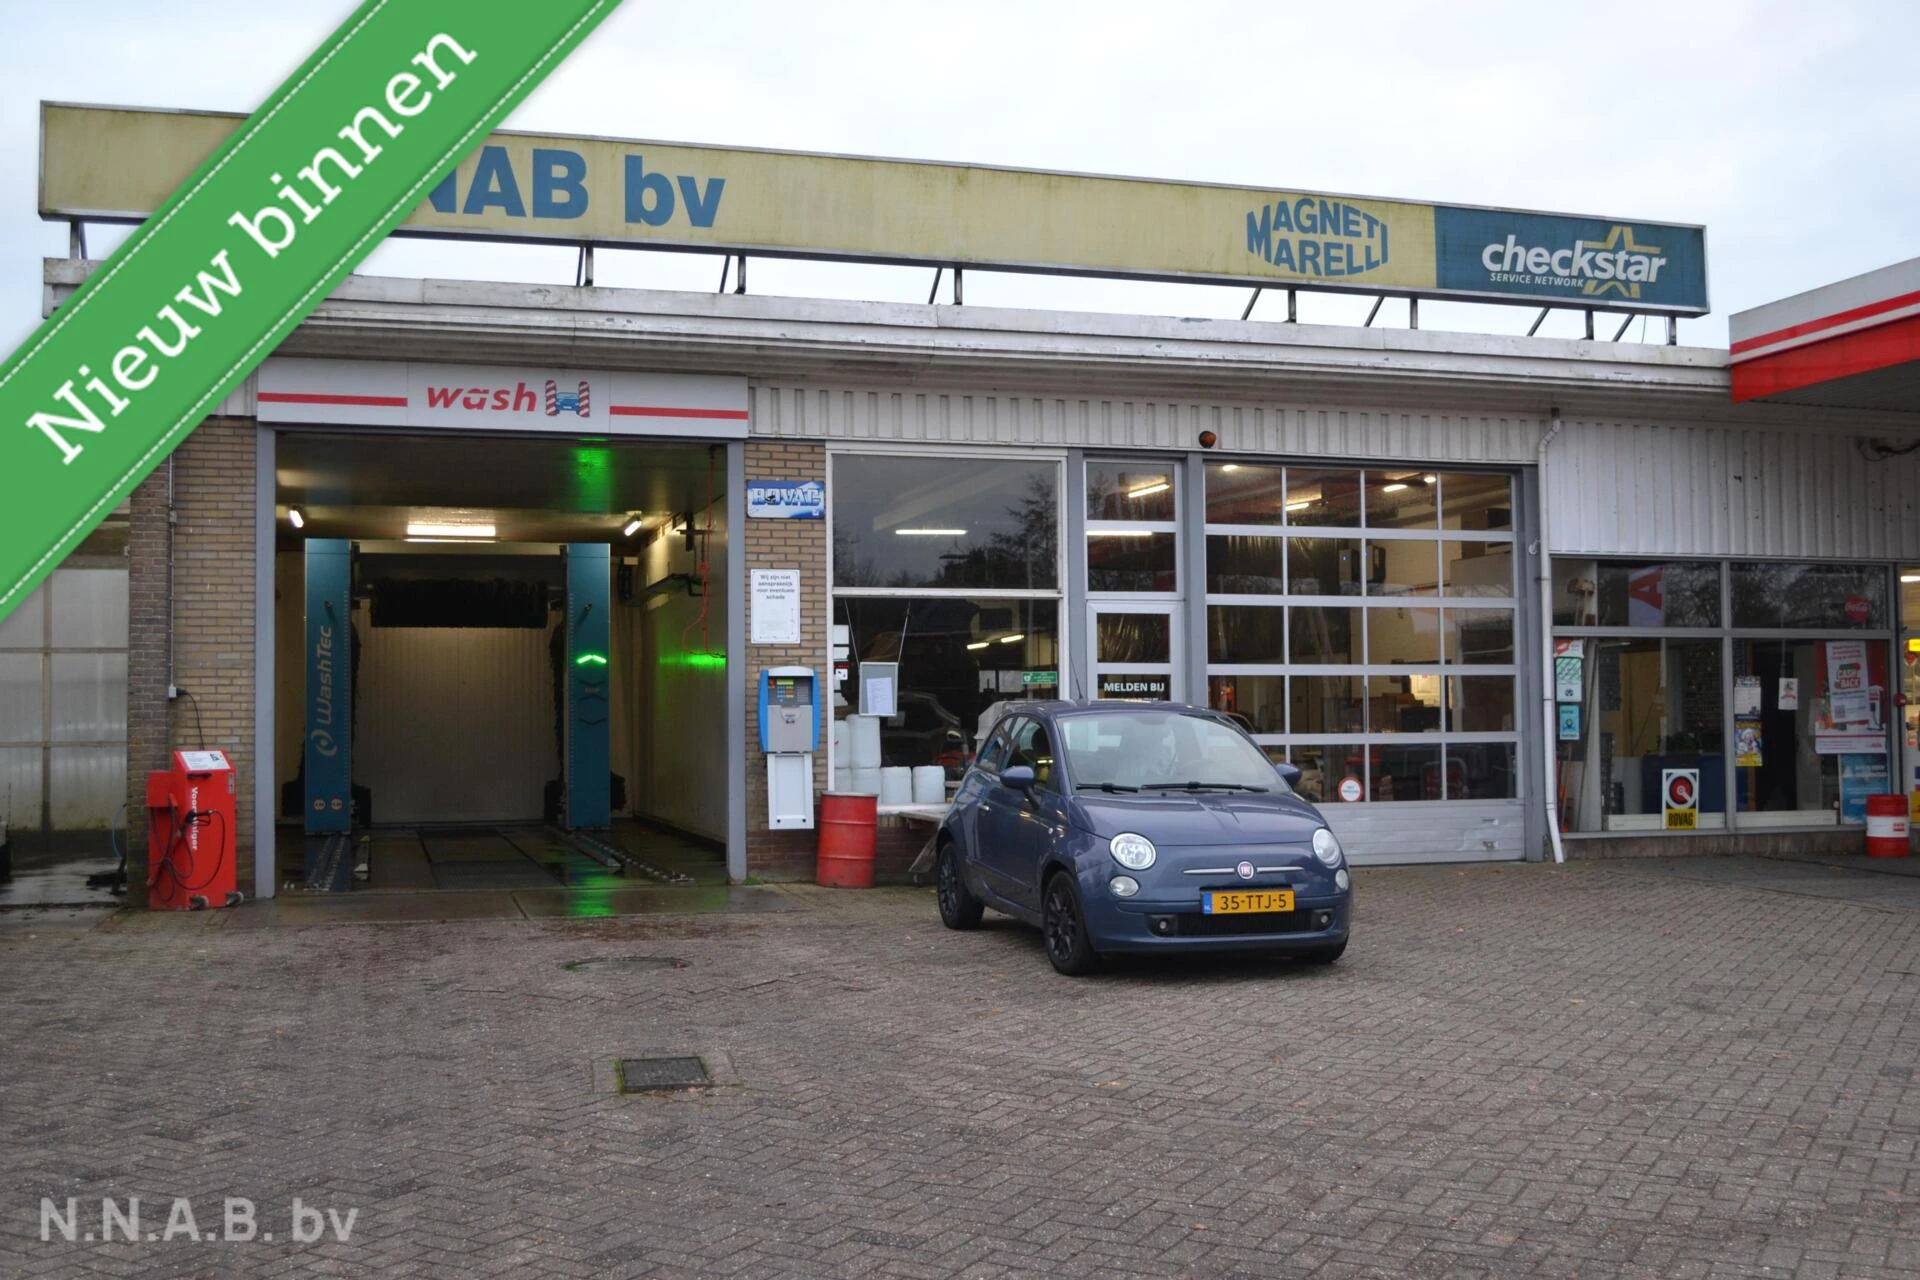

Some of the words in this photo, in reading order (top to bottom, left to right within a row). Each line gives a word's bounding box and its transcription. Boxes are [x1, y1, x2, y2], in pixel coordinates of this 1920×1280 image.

[624, 154, 726, 228] bv
[1246, 198, 1389, 254] MAGNETI
[1246, 228, 1389, 276] MARELLI
[1482, 234, 1667, 283] checkstar
[1490, 272, 1531, 285] SERVICE
[1534, 275, 1584, 288] NETWORK
[1103, 682, 1148, 692] MELDEN
[1150, 682, 1165, 692] BIJ
[1220, 894, 1287, 910] 35-TTJ-5
